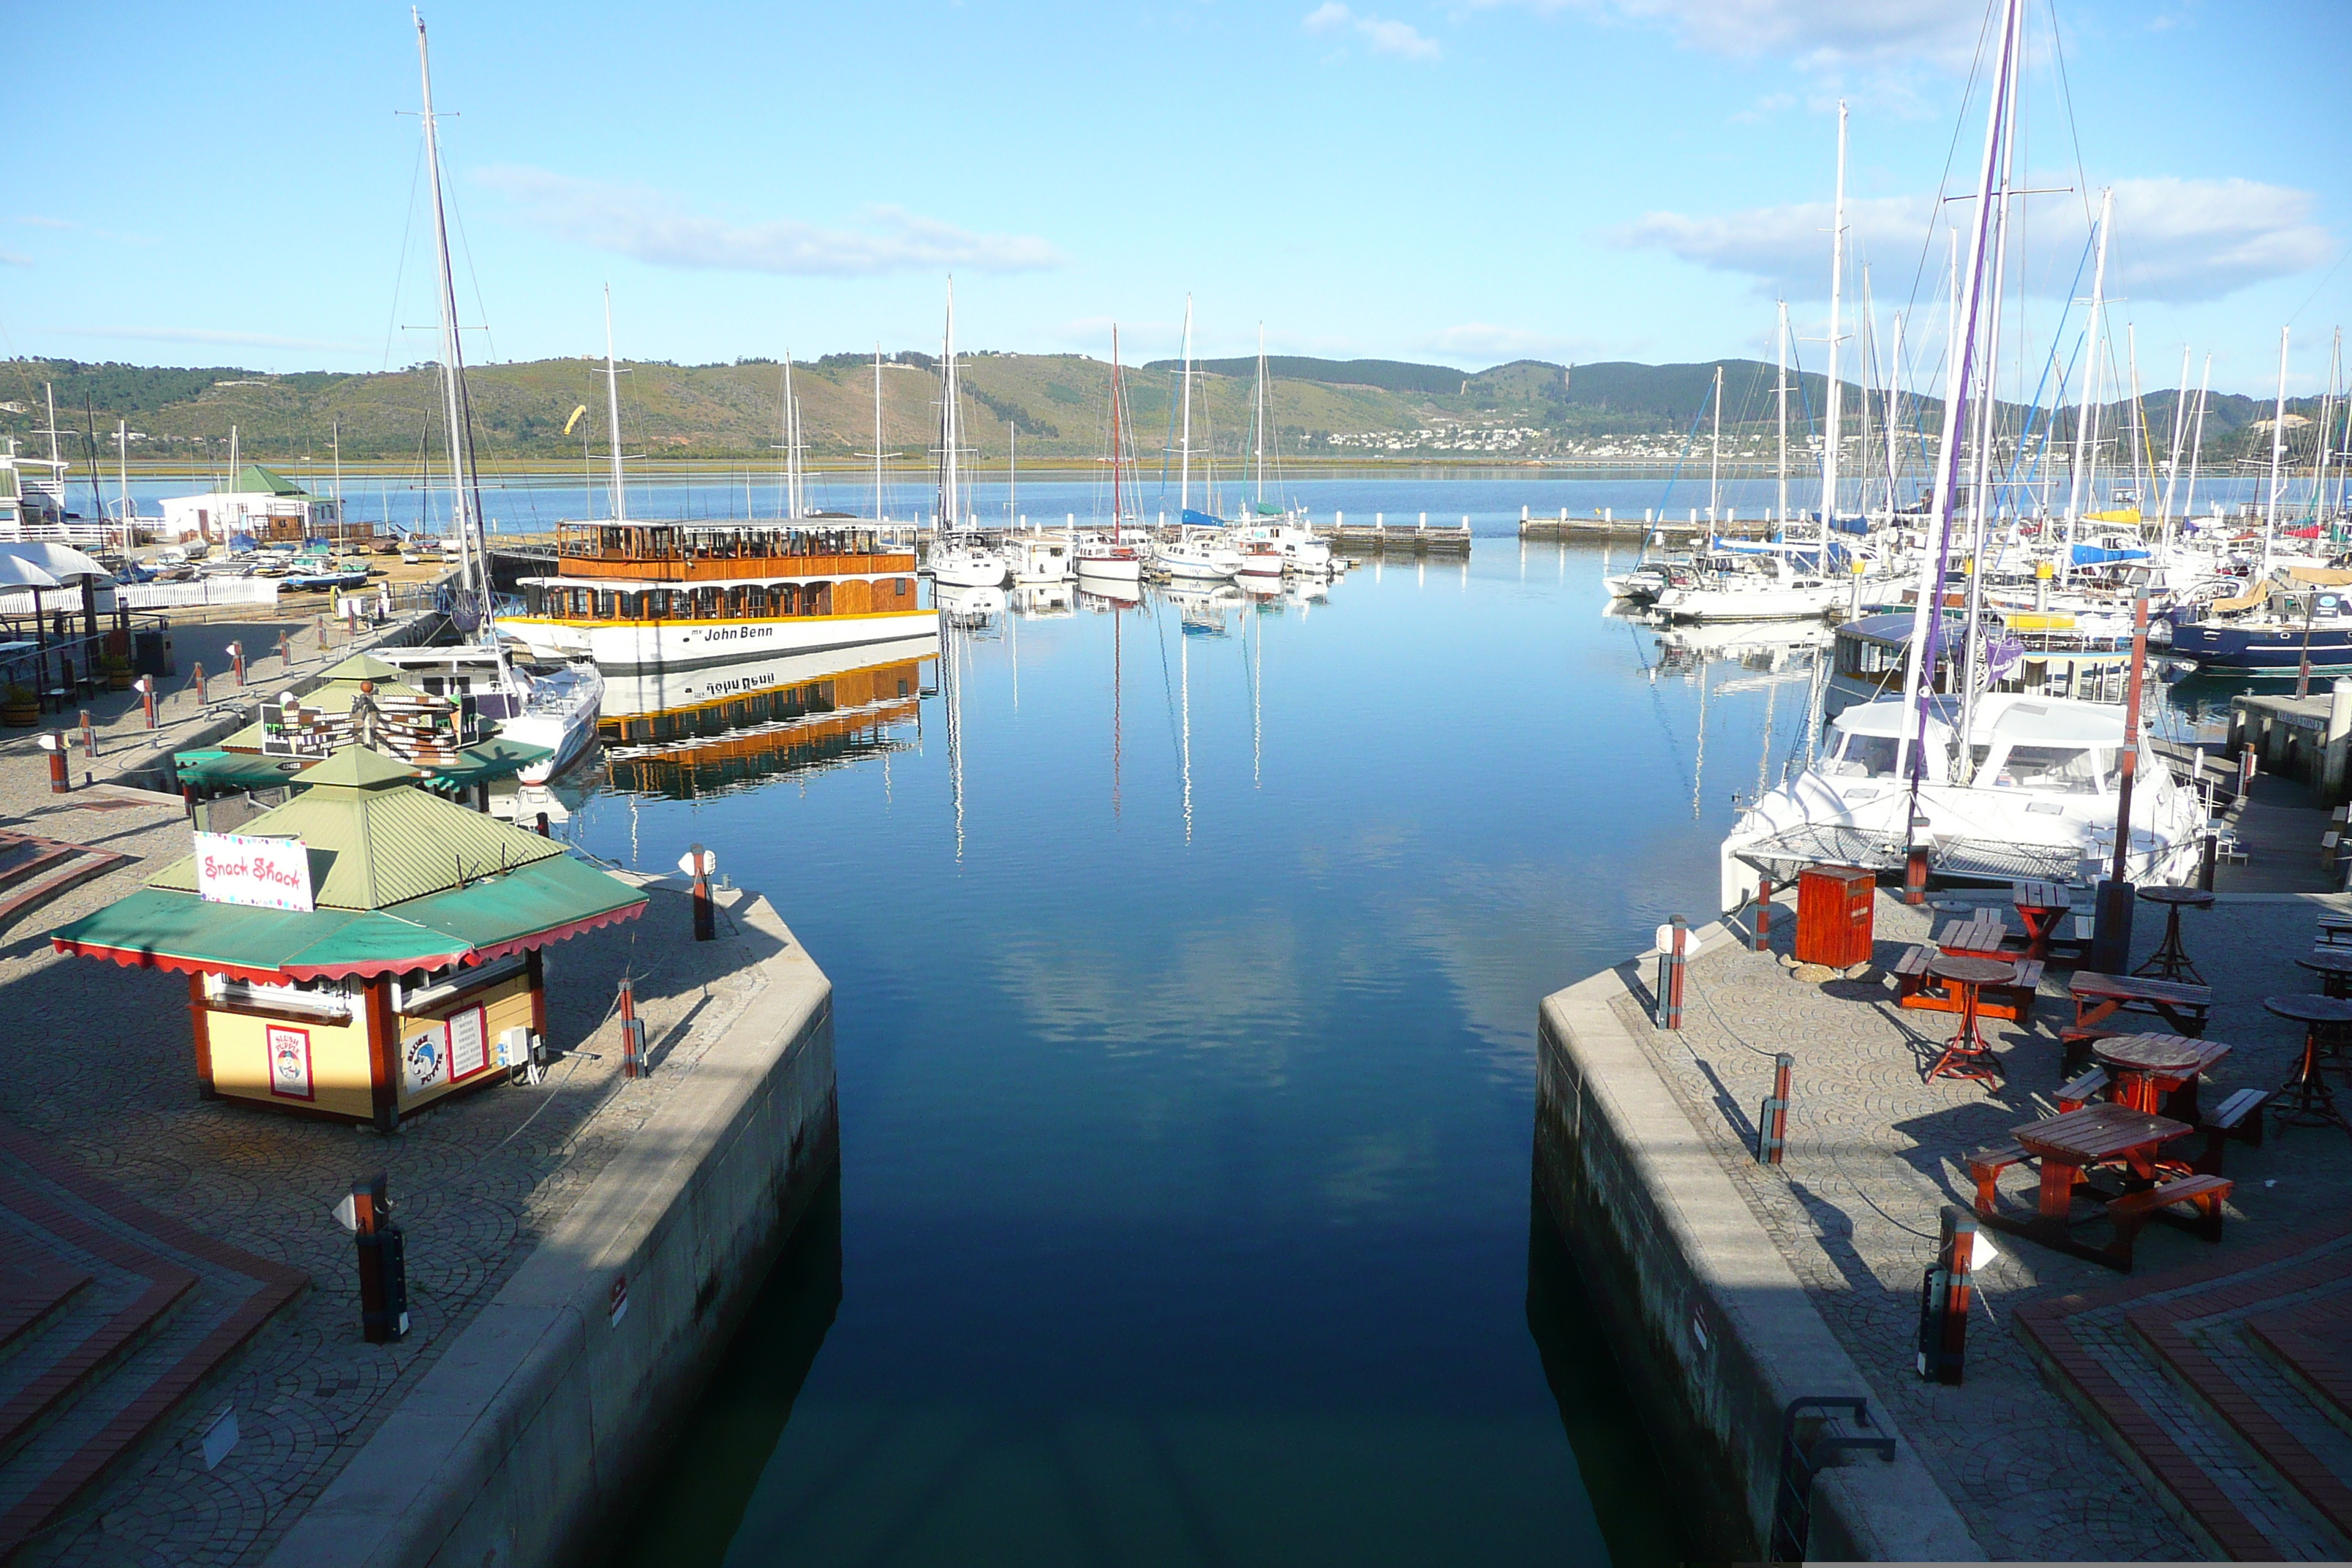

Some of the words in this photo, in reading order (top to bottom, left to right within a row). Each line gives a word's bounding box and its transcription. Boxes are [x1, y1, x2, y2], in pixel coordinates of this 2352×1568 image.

[704, 627, 737, 641] John
[740, 626, 773, 638] Benn
[205, 856, 249, 881] Snack
[252, 857, 300, 889] Shack
[275, 1035, 299, 1047] SLUSH
[275, 1042, 301, 1055] PUPPIE
[407, 1034, 428, 1062] SLUSH
